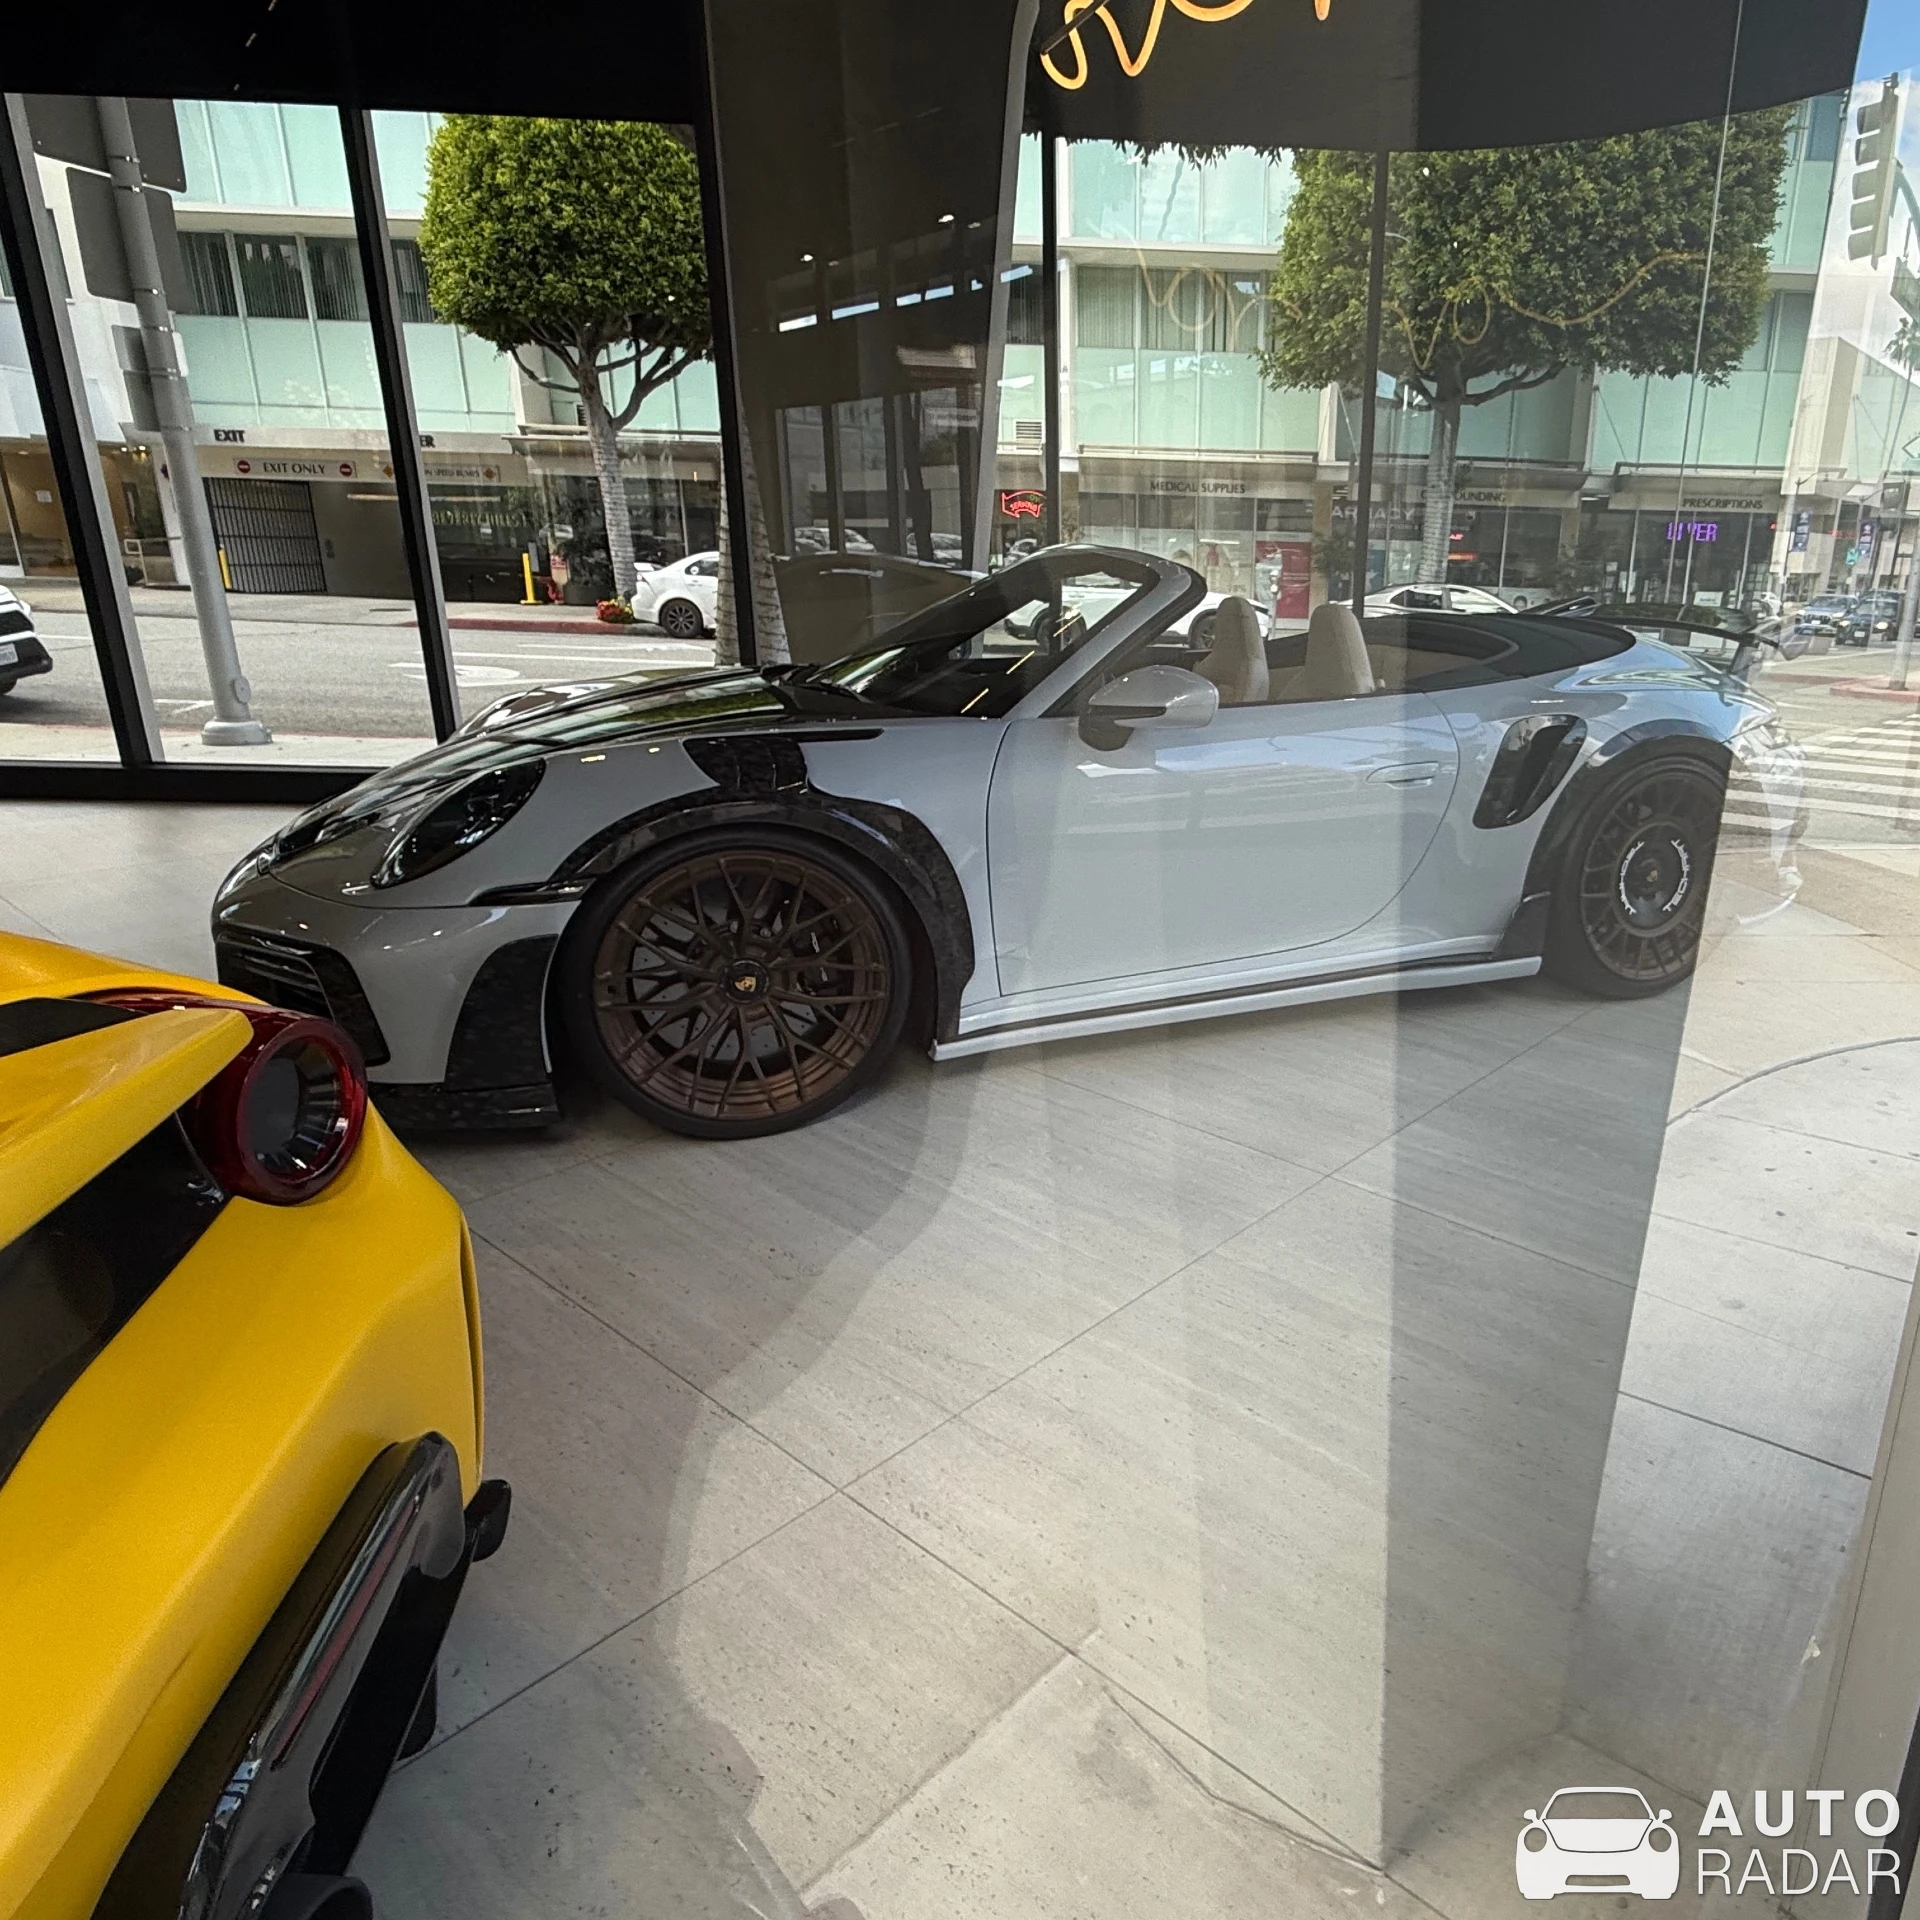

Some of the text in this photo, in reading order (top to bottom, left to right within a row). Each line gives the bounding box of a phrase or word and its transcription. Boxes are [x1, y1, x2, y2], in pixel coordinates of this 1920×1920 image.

[213, 429, 246, 443] EXIT
[263, 462, 326, 475] EXIT ONLY
[1150, 481, 1246, 494] MEDICAL SUPPLIES
[1420, 489, 1505, 502] COUNDING
[1682, 498, 1764, 509] PRESCRIPTIONS
